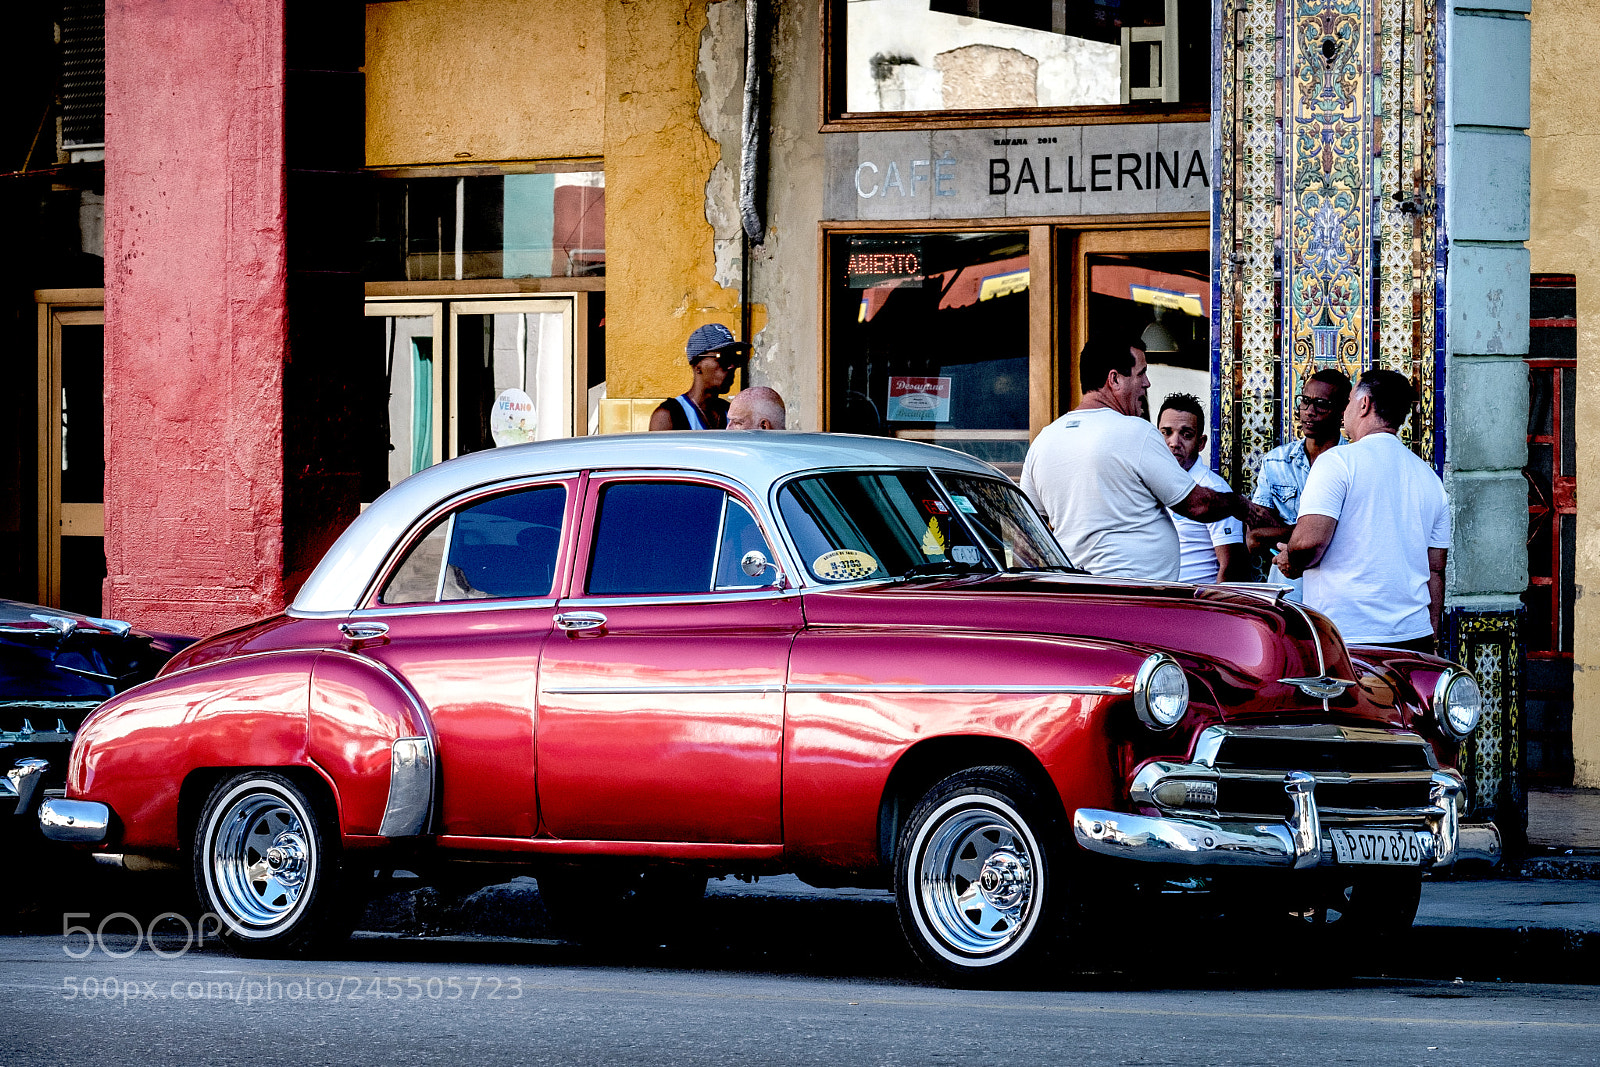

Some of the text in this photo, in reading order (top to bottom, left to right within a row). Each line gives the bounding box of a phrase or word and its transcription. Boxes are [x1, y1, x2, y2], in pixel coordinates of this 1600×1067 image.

[855, 150, 1211, 199] CAFÉ BALLERINA
[847, 253, 918, 274] ABIERTO
[896, 380, 945, 394] Desayuno
[499, 402, 531, 411] VERANO
